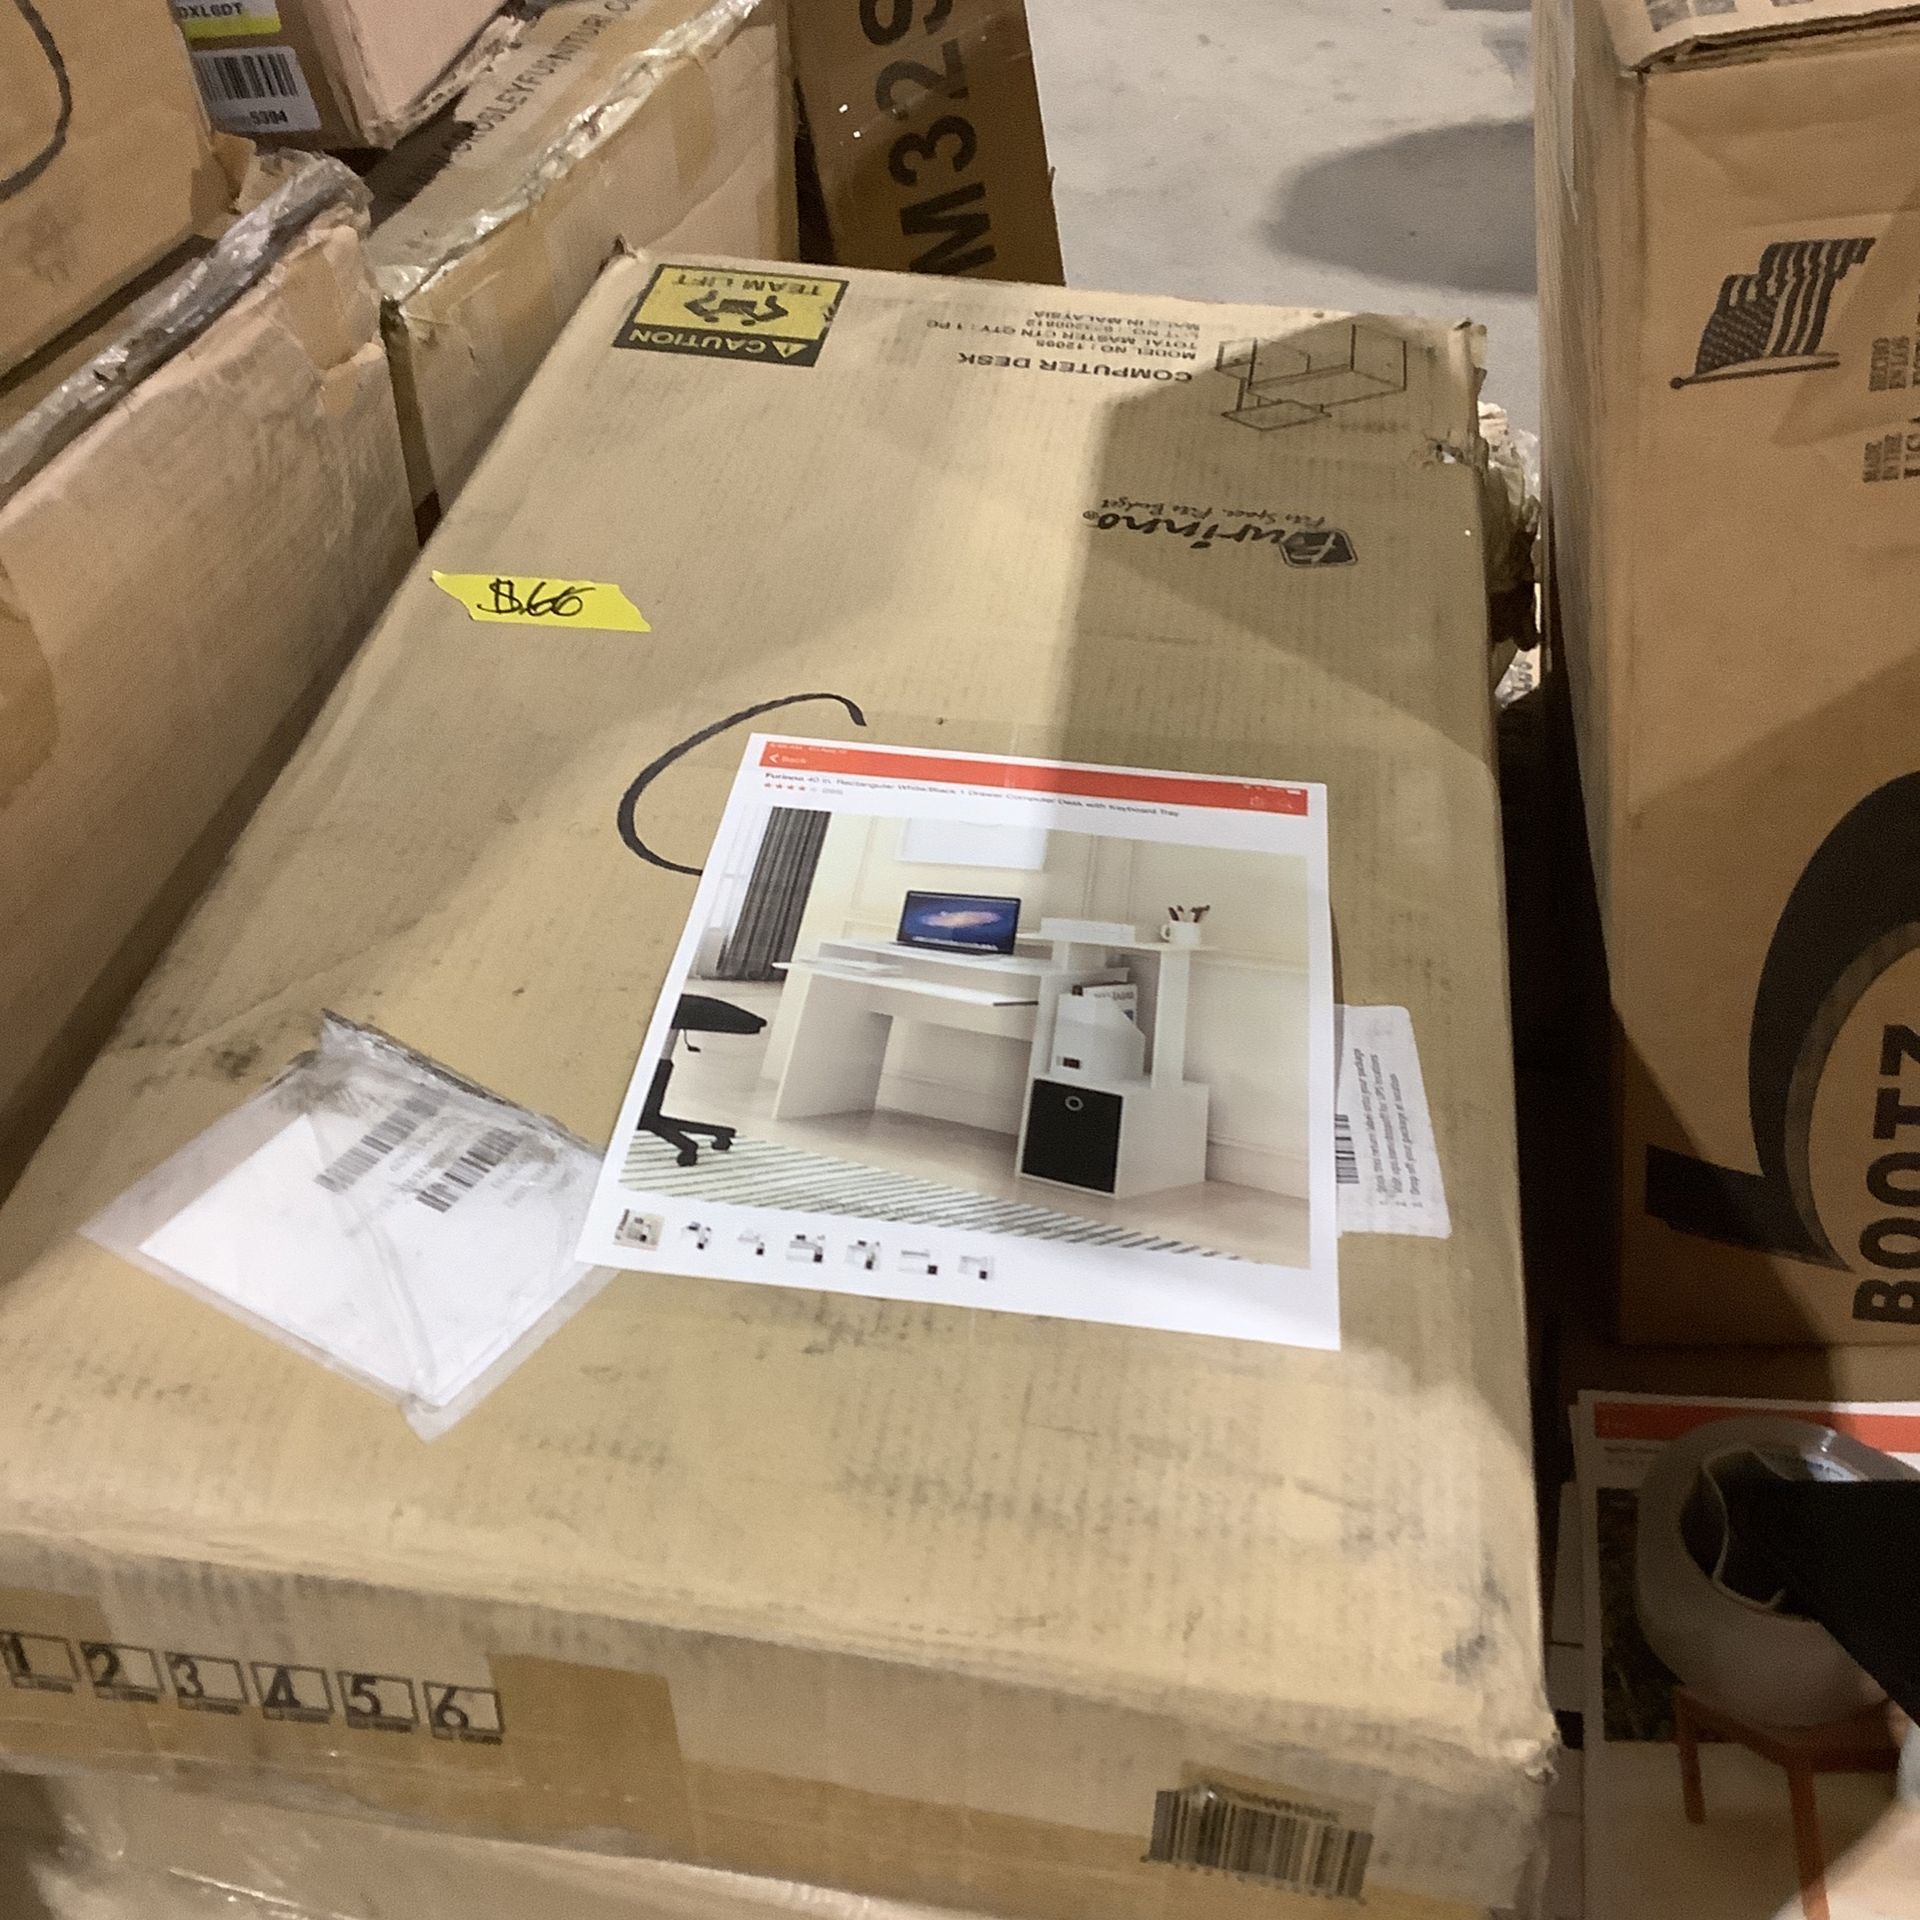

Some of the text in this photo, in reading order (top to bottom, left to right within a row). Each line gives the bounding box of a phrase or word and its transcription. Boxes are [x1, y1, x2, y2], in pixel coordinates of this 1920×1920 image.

[673, 273, 820, 296] TEAM LIFT
[926, 319, 950, 330] PC
[1033, 310, 1123, 326] MALAYSIA
[1127, 316, 1144, 327] IN
[979, 324, 1017, 335] QTY
[1020, 328, 1057, 339] CTN
[629, 328, 767, 354] CAUTION
[1062, 330, 1136, 346] MASTER
[1144, 336, 1197, 350] TOTAL
[1137, 346, 1197, 361] MODEL
[956, 351, 1194, 382] COMPUTER DESK
[1354, 1048, 1367, 1077] package
[1397, 1112, 1414, 1144] package
[1852, 1024, 1920, 1325] BOOTZ
[86, 1643, 122, 1687] 2
[169, 1654, 207, 1698] 3
[264, 1664, 303, 1709] 4
[350, 1673, 384, 1716] 5
[433, 1685, 469, 1728] 6
